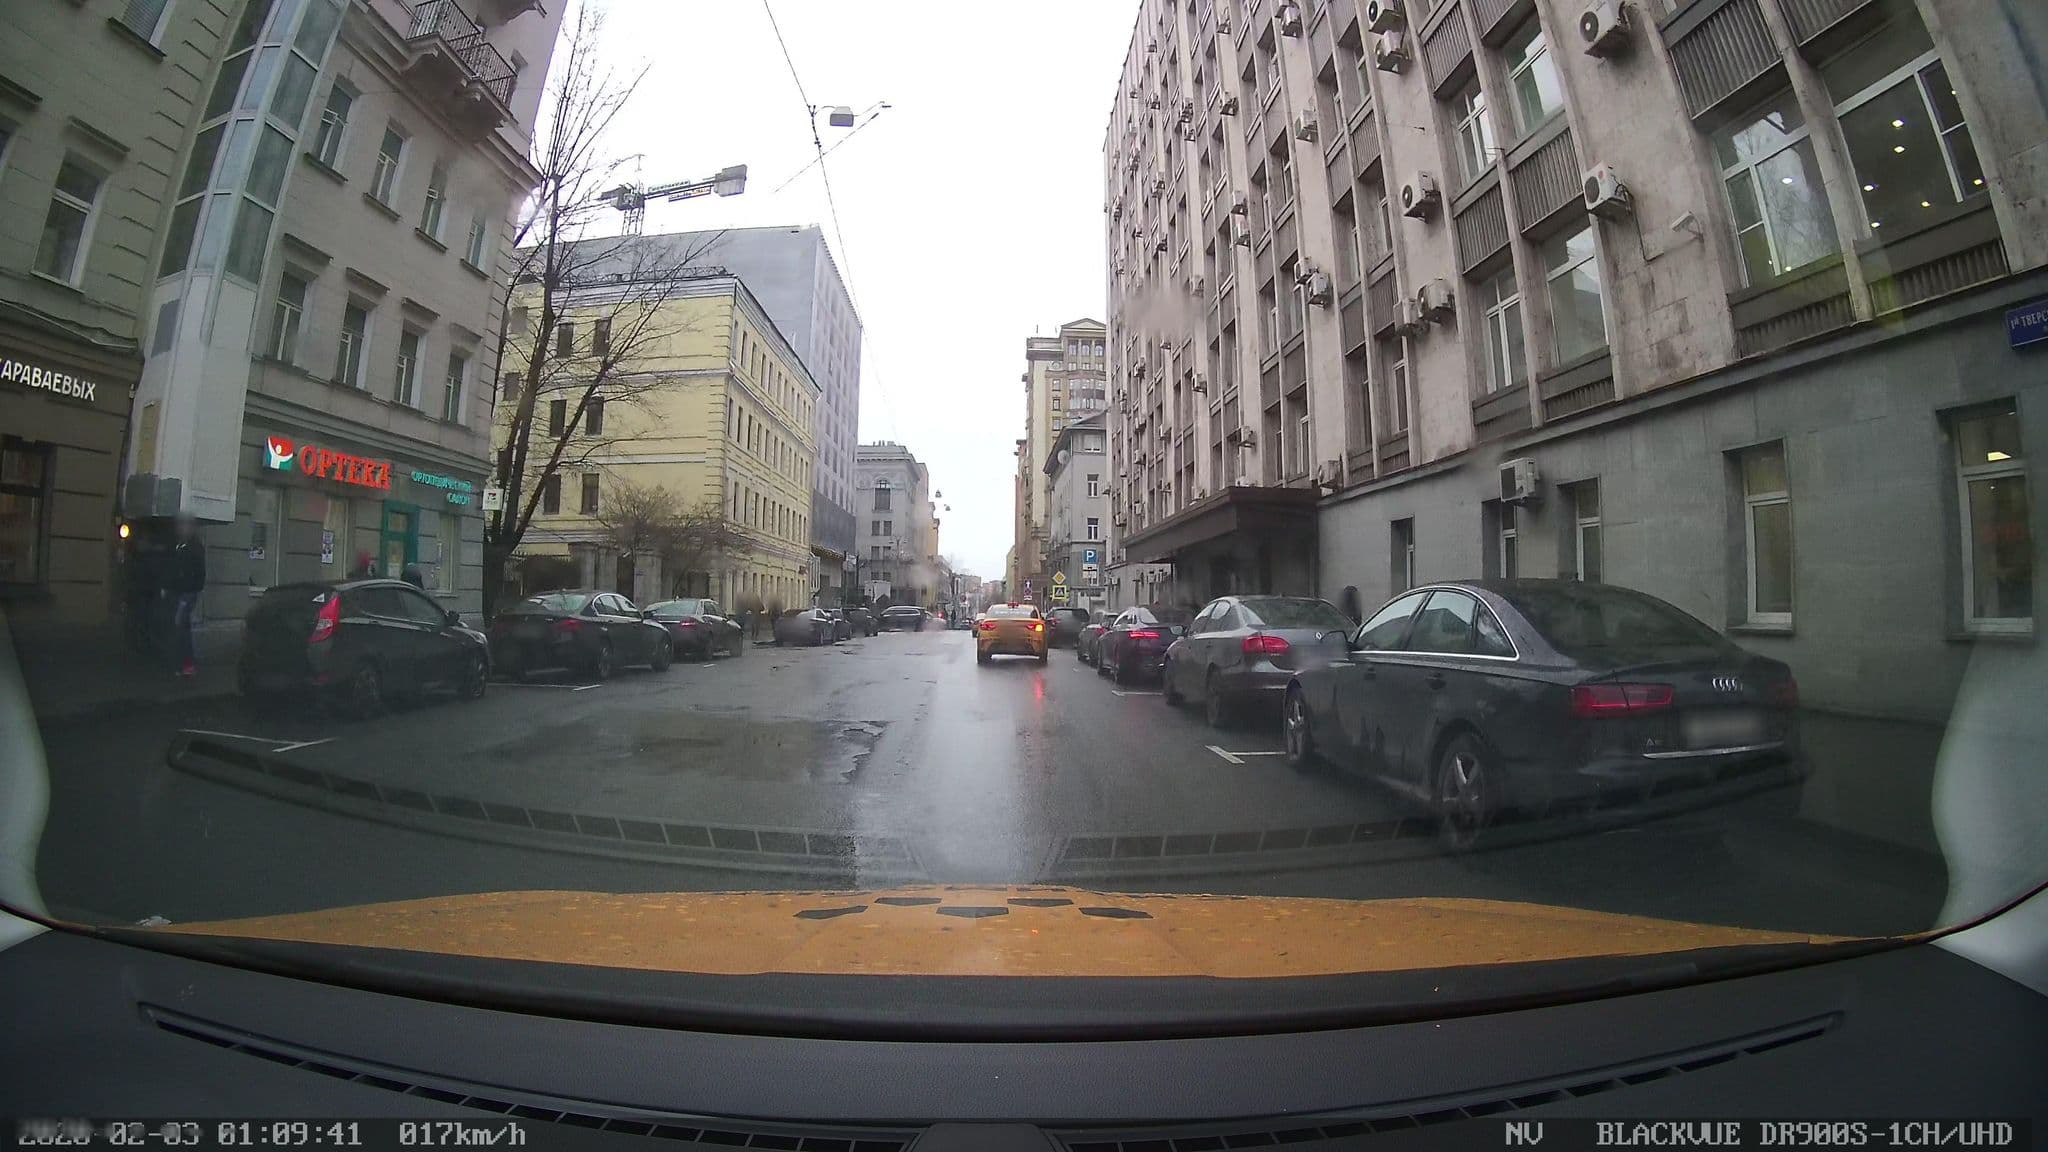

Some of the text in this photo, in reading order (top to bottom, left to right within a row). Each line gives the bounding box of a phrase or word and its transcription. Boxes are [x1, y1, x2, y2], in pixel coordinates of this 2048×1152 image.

[2020, 310, 2048, 327] ТВЕРС
[0, 358, 96, 401] АРАВАЕВЫХ
[300, 444, 391, 490] ОРТЕКА
[1086, 550, 1095, 562] P
